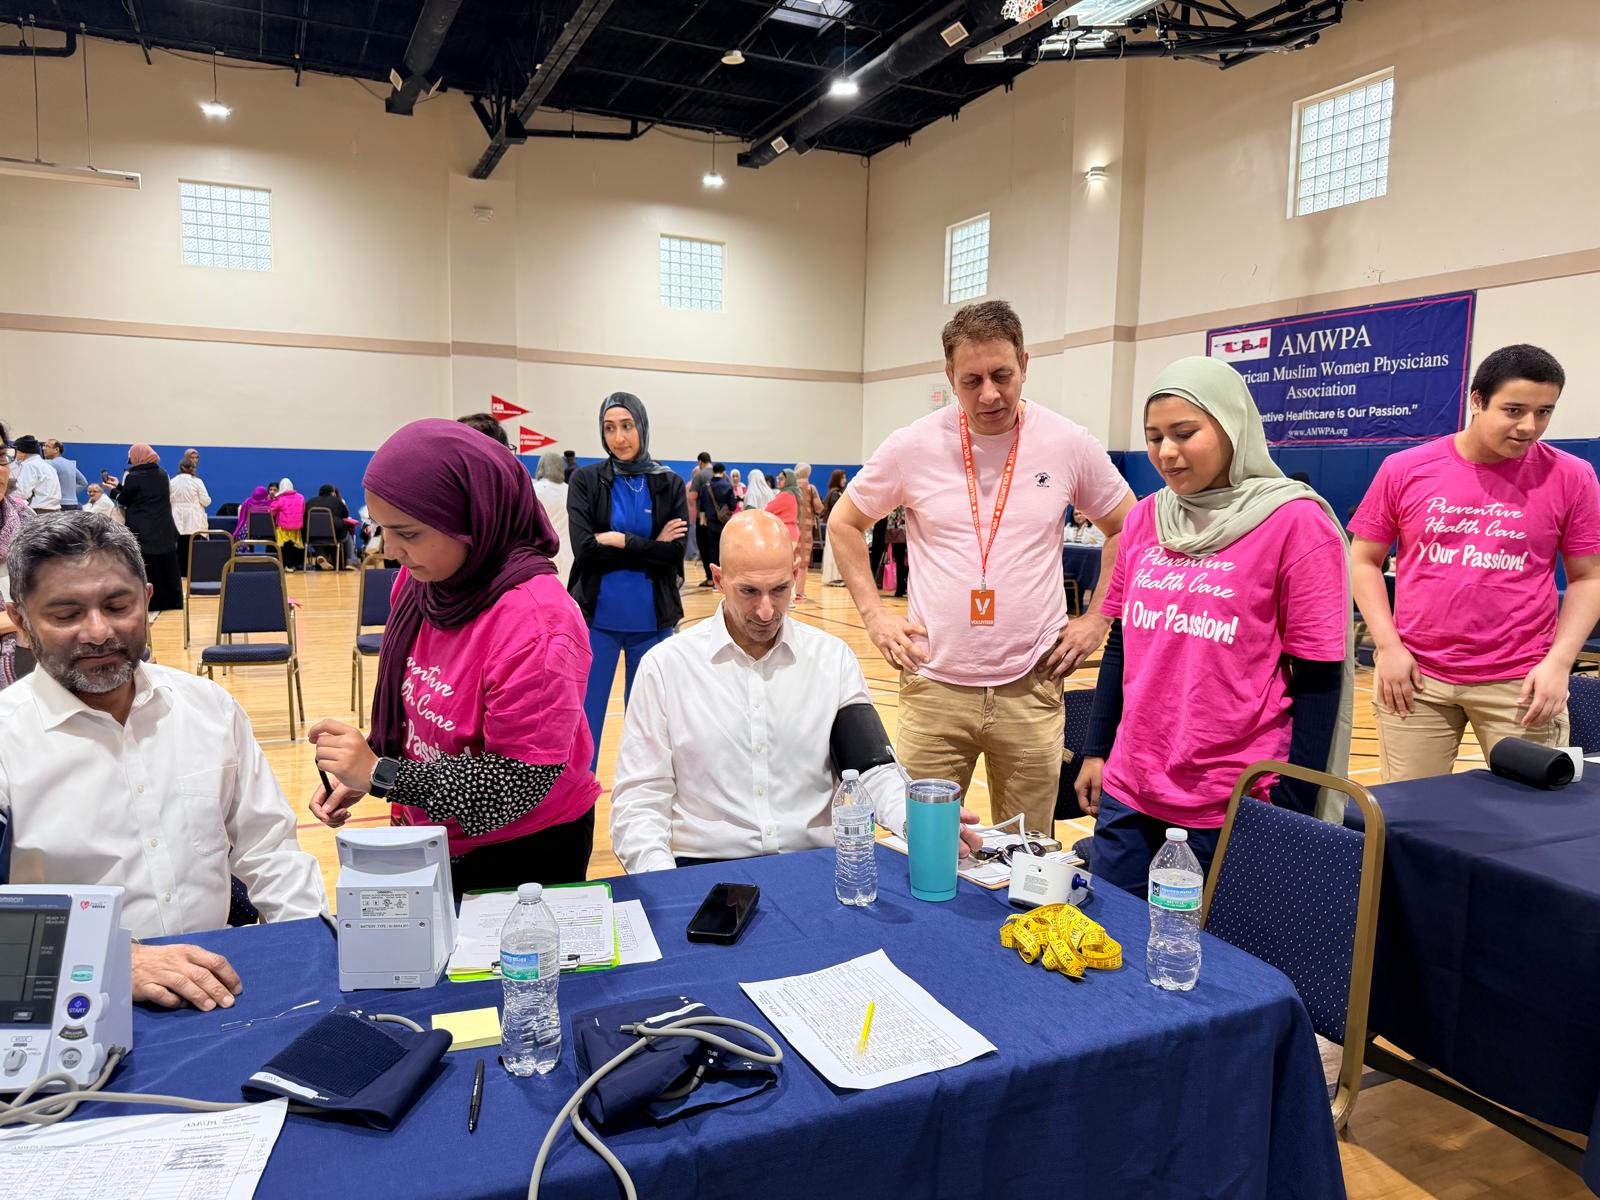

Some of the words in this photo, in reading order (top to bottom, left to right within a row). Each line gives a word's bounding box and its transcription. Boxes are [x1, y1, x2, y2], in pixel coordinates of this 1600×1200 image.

[1278, 324, 1372, 357] AMWPA
[1243, 370, 1270, 384] rican
[1273, 364, 1317, 382] Muslim
[1321, 361, 1370, 376] Women
[1373, 352, 1449, 375] Physicians
[1286, 381, 1357, 400] Association
[1260, 411, 1283, 422] entive
[1286, 409, 1335, 422] Healthcare
[1337, 407, 1345, 418] is
[1347, 407, 1366, 418] Our
[1288, 427, 1349, 438] www.AMWPA.org
[966, 467, 976, 503] VOLUNTEER
[997, 472, 1011, 509] VOLUNTEER
[1427, 497, 1523, 518] Preventive
[1425, 516, 1480, 535] Health
[1485, 520, 1527, 539] Care
[1141, 546, 1236, 571] Preventive
[1462, 544, 1528, 572] Passion!
[1132, 568, 1186, 591] Health
[1189, 572, 1235, 598] Care
[975, 599, 991, 615] V
[1132, 601, 1163, 630] Our
[1165, 603, 1239, 645] Passion!
[417, 694, 456, 731] Care
